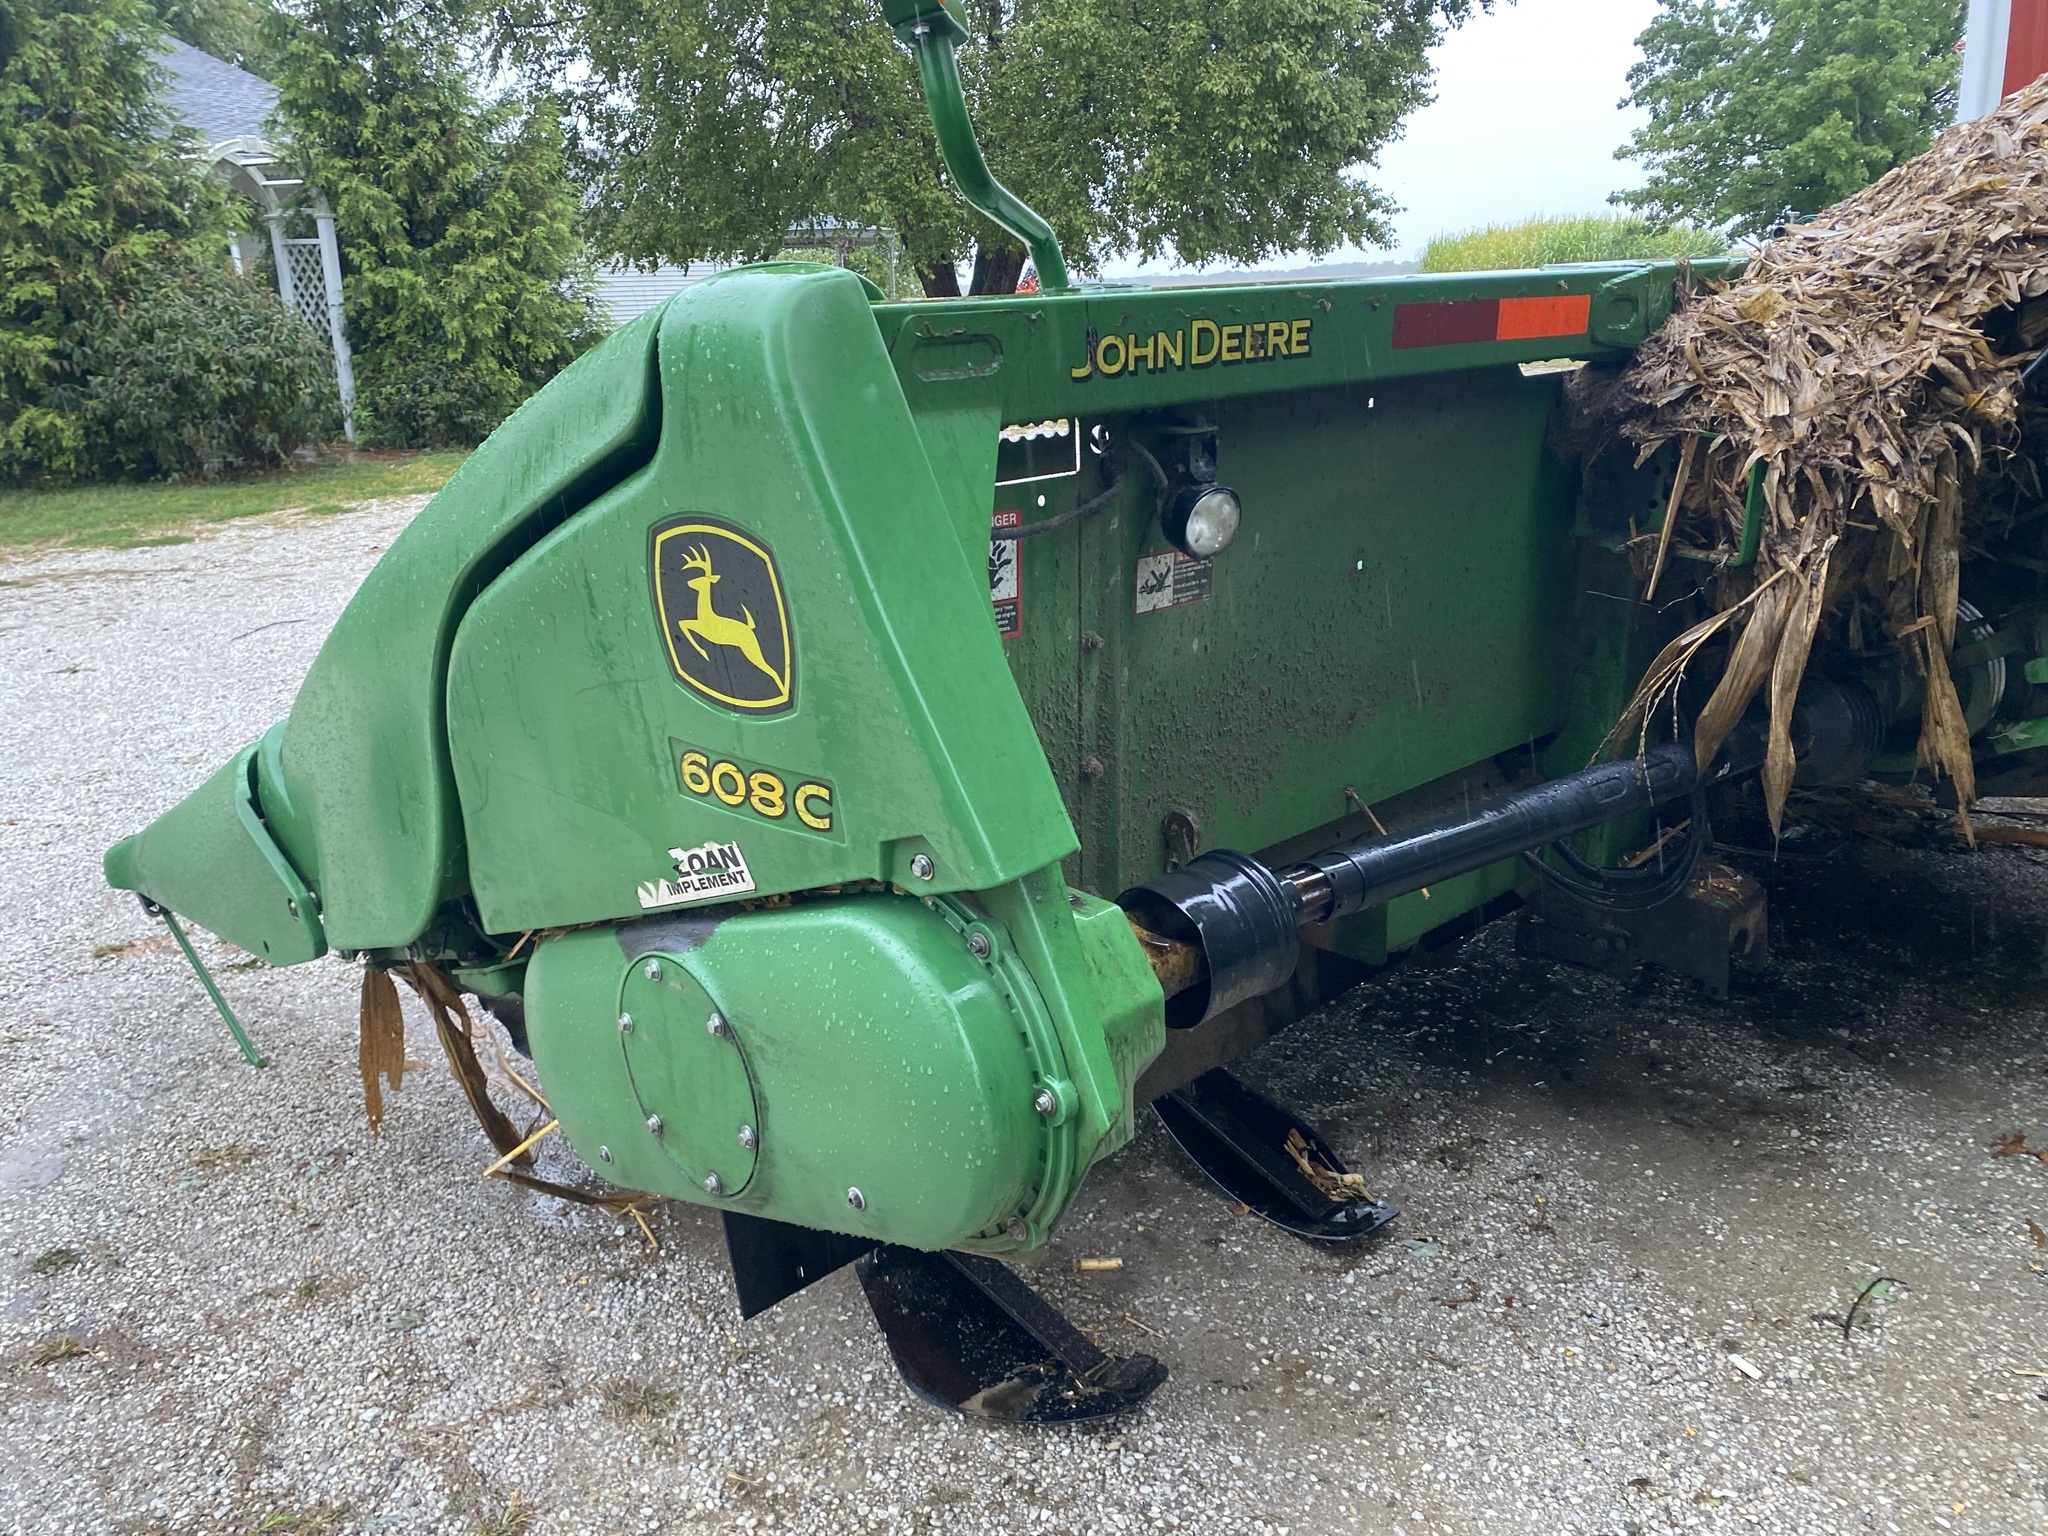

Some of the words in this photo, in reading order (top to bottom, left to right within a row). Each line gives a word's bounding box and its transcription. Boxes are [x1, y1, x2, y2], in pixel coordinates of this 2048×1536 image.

[1071, 326, 1186, 383] JOHN
[1190, 317, 1312, 370] DEERE
[992, 512, 1017, 526] GER
[666, 870, 747, 896] IMPLEMENT
